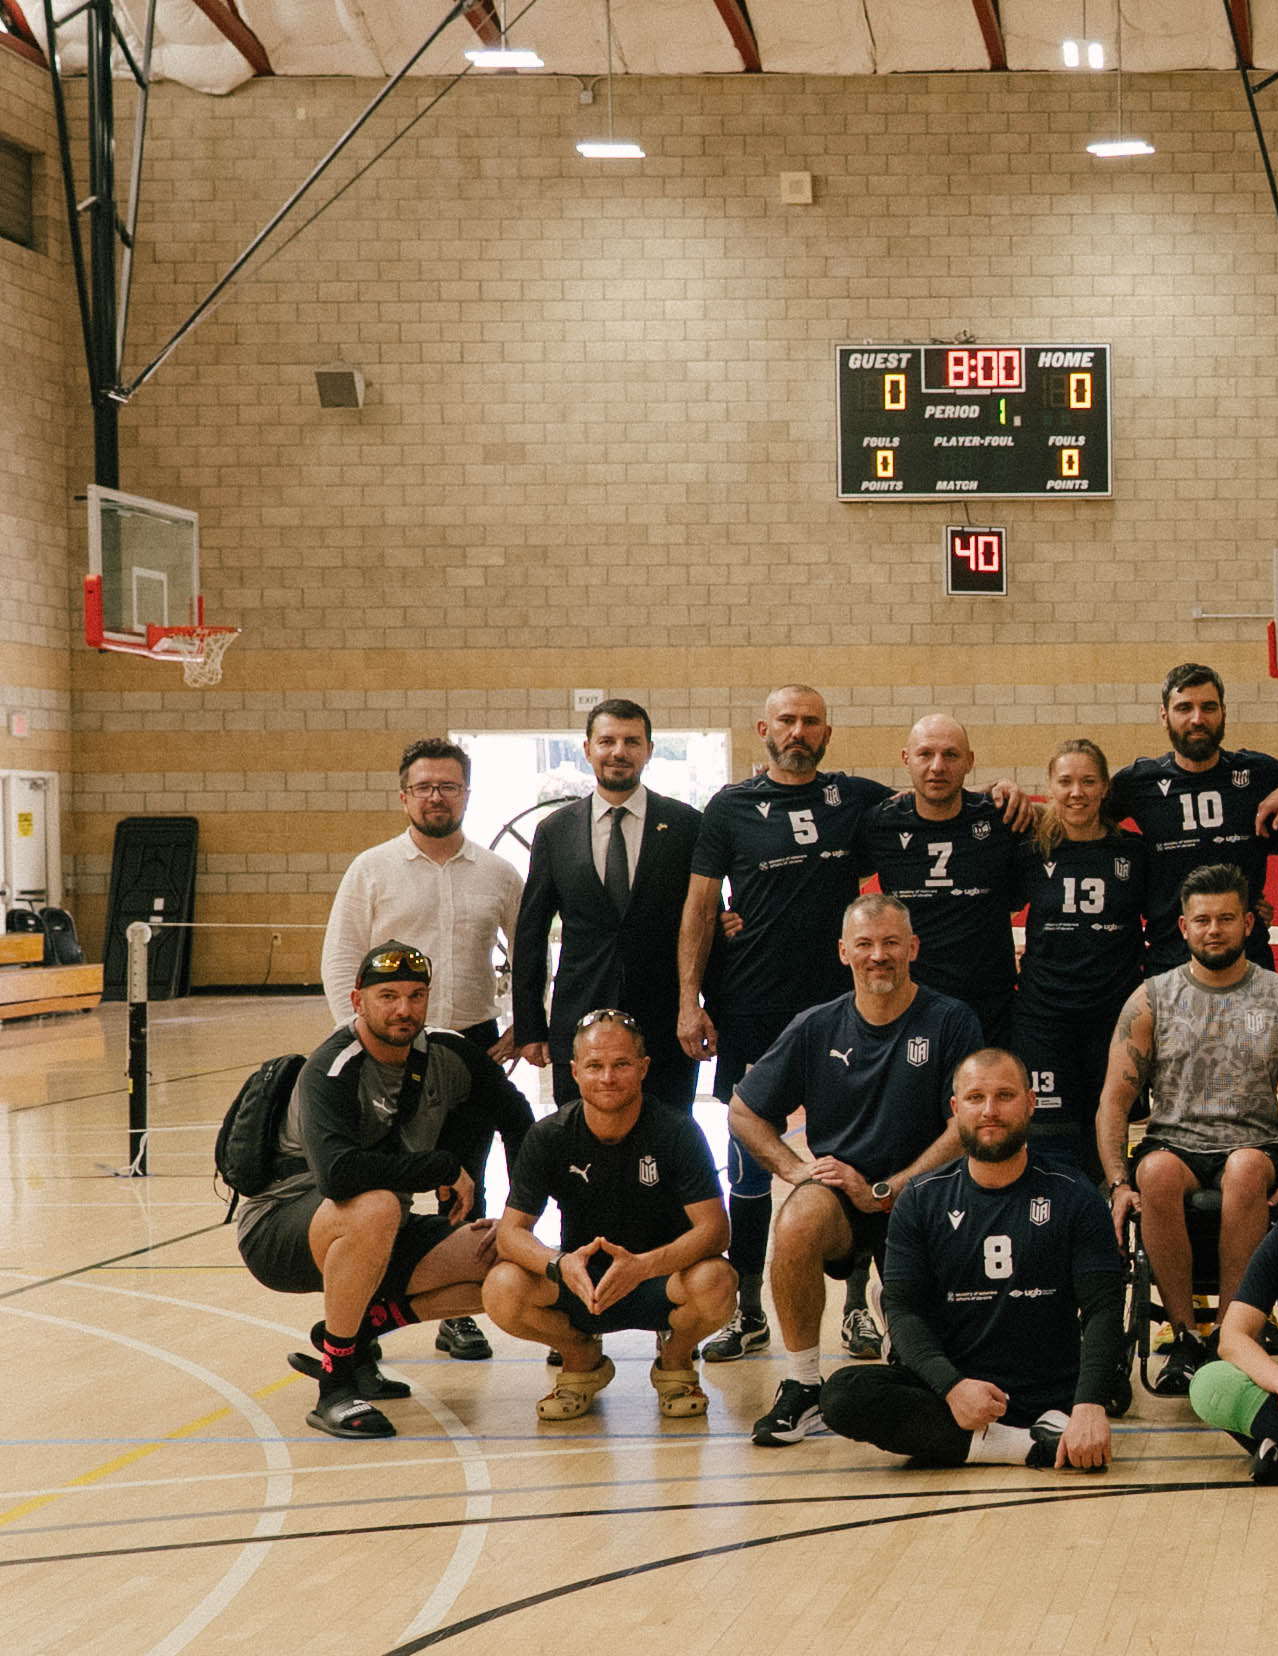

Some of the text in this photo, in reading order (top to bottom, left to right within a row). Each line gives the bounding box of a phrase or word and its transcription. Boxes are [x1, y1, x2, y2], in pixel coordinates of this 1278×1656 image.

[848, 353, 911, 369] GUEST
[948, 350, 1021, 387] 8:00
[1038, 352, 1094, 368] HOME
[884, 374, 906, 410] 0
[1069, 373, 1092, 409] 0
[924, 405, 980, 418] PERIOD
[999, 398, 1006, 424] 1
[862, 436, 900, 447] FOULS
[933, 436, 1015, 447] PLAYER-FOUL
[1048, 436, 1085, 446] FOULS
[876, 450, 894, 478] 0
[1061, 449, 1080, 476] 0
[861, 480, 903, 490] POINTS
[936, 480, 978, 490] MATCH
[1046, 479, 1088, 490] POINTS
[954, 536, 1000, 572] 40
[1180, 791, 1224, 831] 10
[788, 809, 820, 845] 5
[928, 841, 953, 878] 7
[1062, 877, 1106, 914] 13
[1032, 1071, 1055, 1093] 13
[984, 1235, 1014, 1280] 8
